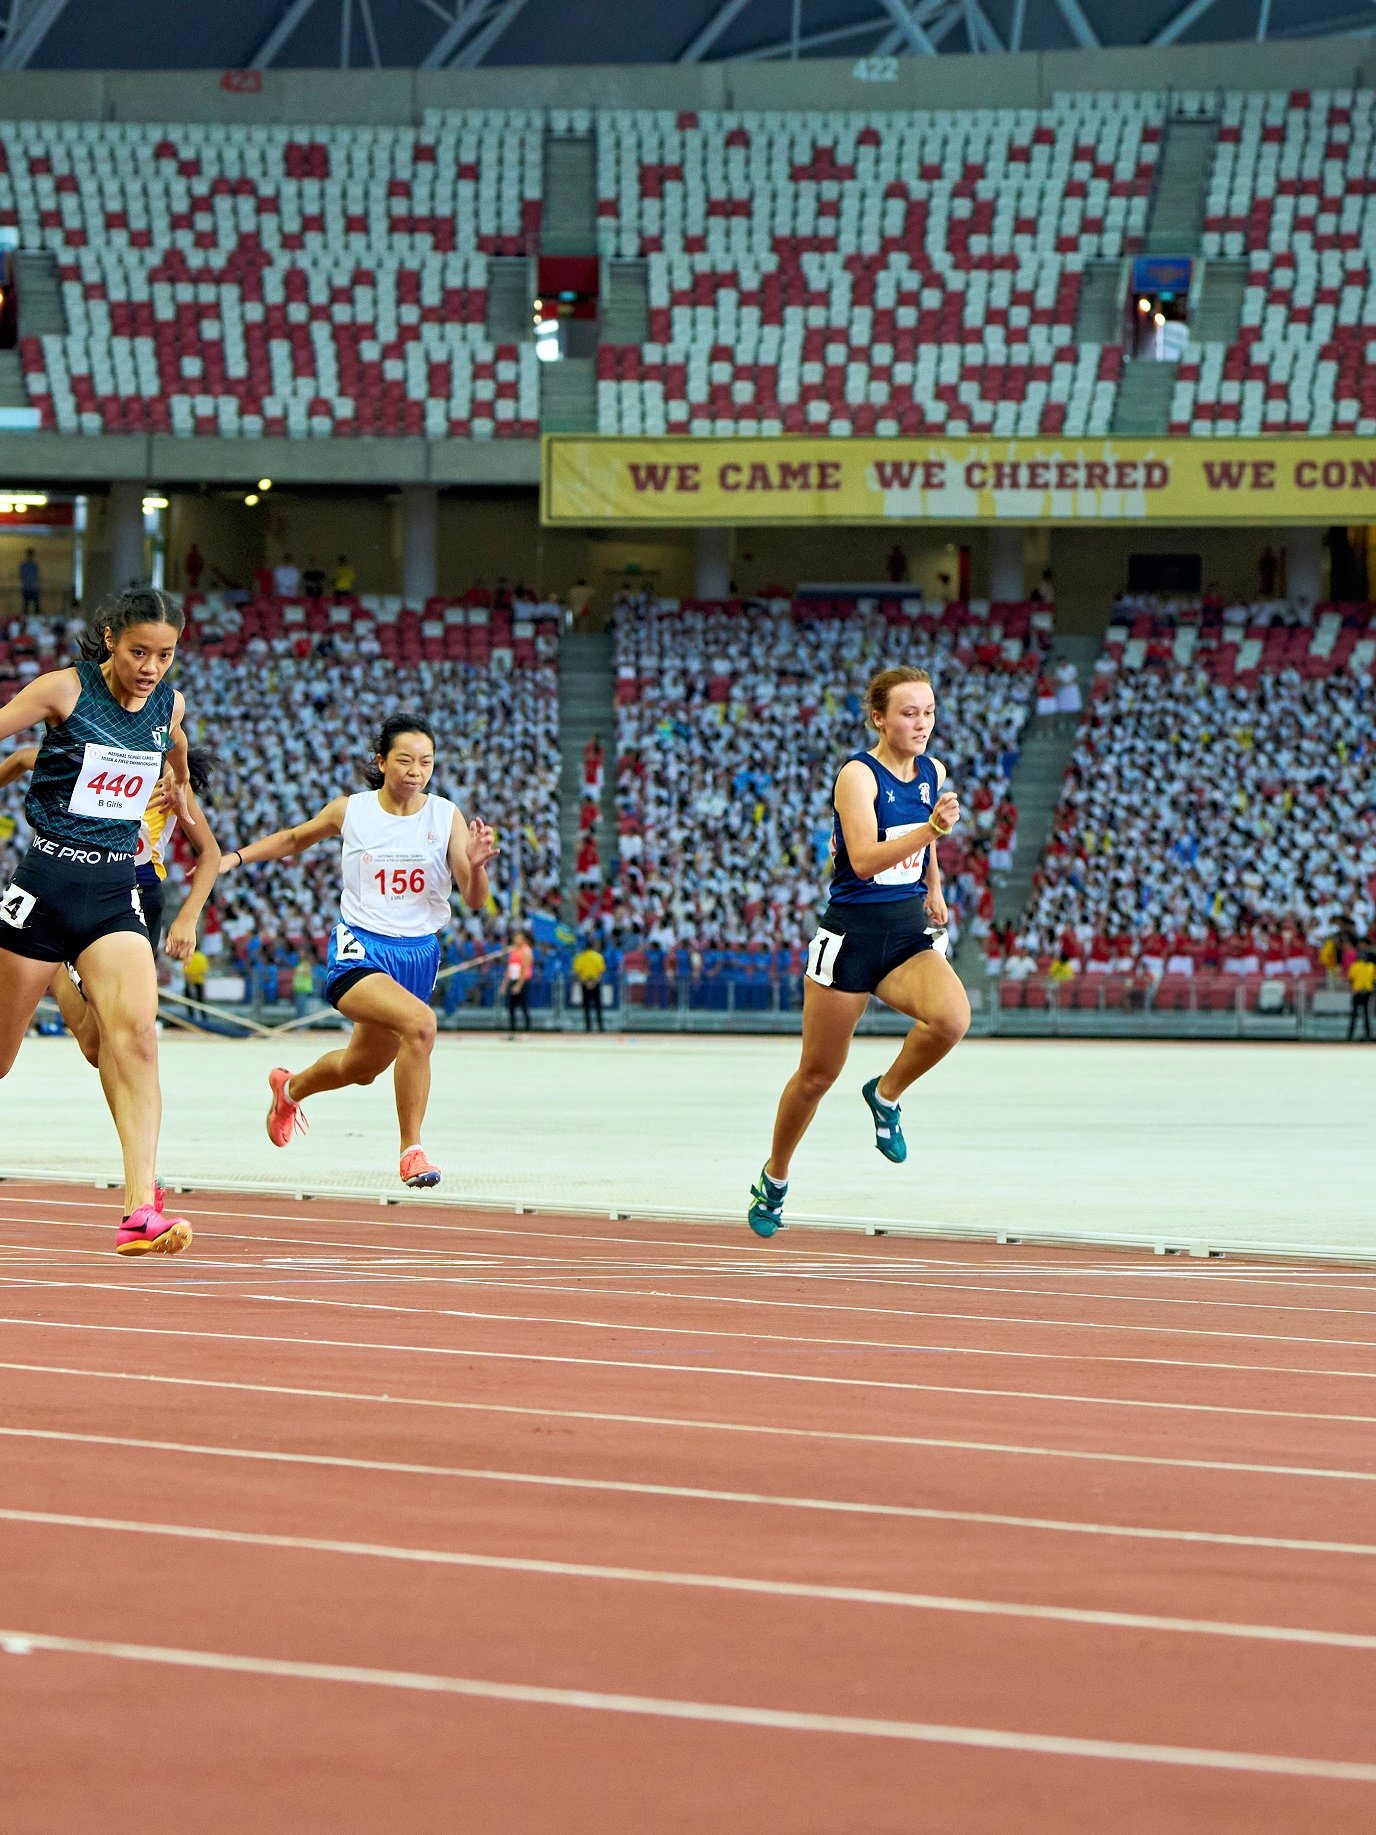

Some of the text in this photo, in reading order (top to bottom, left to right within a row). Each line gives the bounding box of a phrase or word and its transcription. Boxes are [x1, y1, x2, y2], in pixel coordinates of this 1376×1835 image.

[853, 57, 898, 81] 422
[219, 71, 263, 93] 423
[628, 463, 700, 491] WE
[717, 461, 842, 491] CAME
[873, 460, 946, 490] WE
[964, 460, 1170, 490] CHEERED
[1202, 460, 1276, 490] WE
[87, 772, 144, 798] 440
[98, 799, 123, 809] B Girls
[57, 846, 102, 865] PRO
[374, 868, 425, 895] 156
[4, 895, 24, 920] 4
[342, 929, 358, 953] 2
[814, 936, 830, 976] 1
